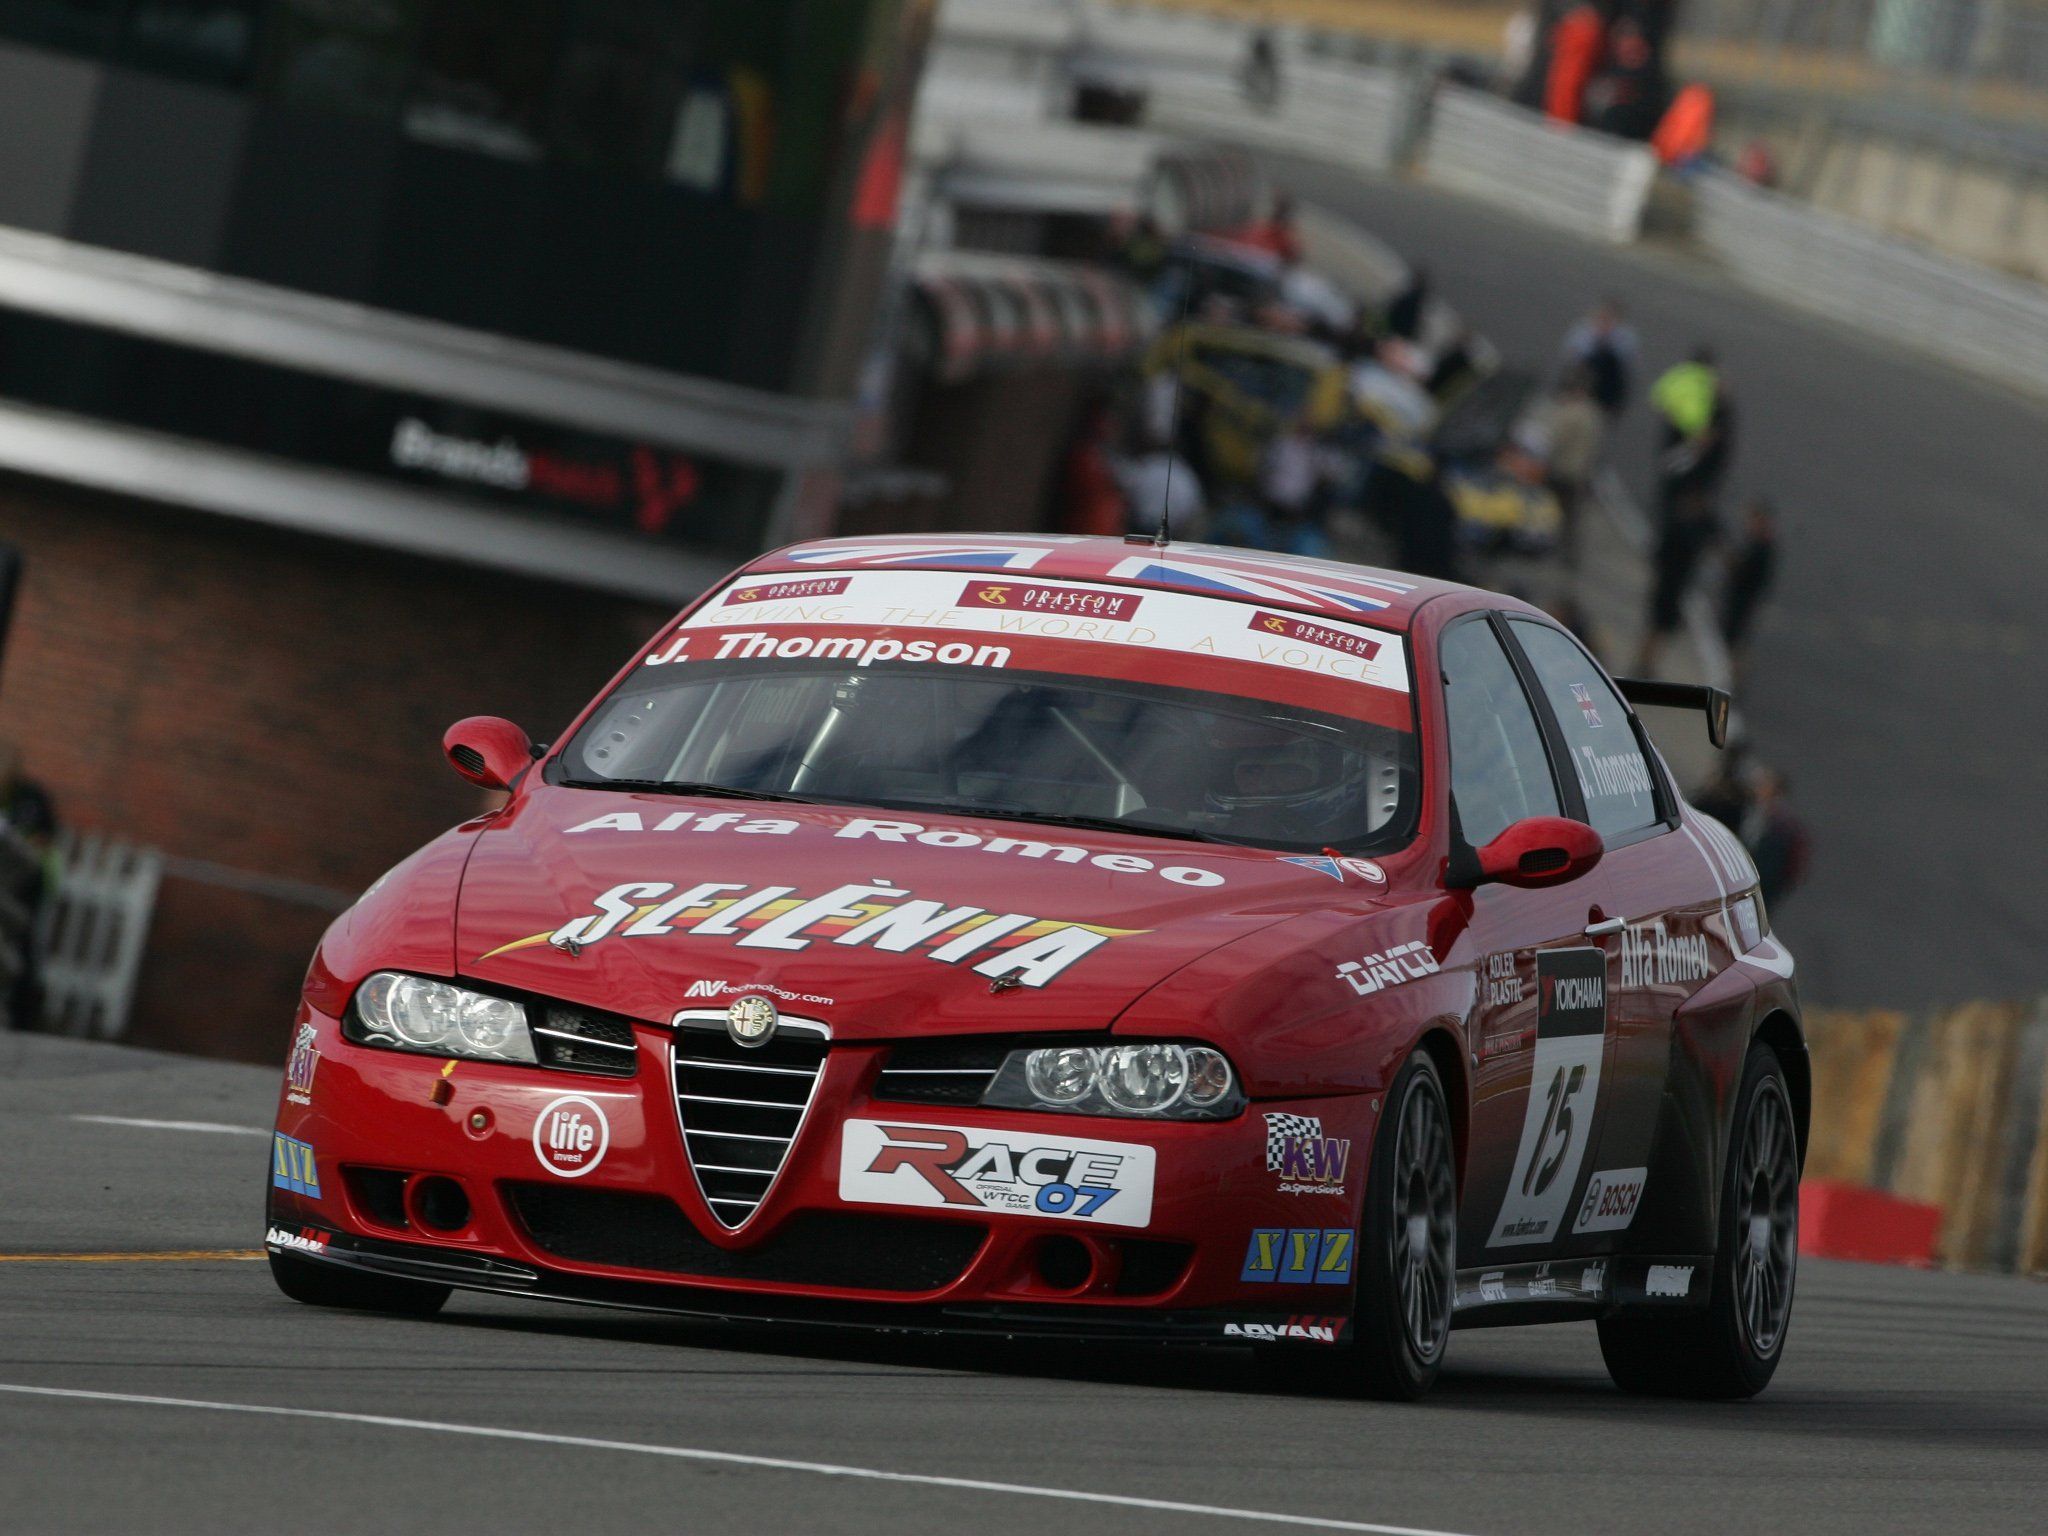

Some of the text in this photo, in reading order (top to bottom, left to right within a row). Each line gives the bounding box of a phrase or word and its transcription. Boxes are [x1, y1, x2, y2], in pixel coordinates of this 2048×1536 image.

[768, 580, 839, 595] ORASCOM
[1023, 589, 1125, 612] ORASCOM
[1022, 602, 1117, 616] TELECOM
[645, 632, 1011, 668] J. Thompson
[709, 605, 1384, 683] GIVING THE WORLD A VOICE
[1296, 623, 1369, 653] ORASCOM
[562, 811, 1226, 888] Alfa Romeo
[1336, 939, 1441, 996] DAYCO
[1490, 952, 1516, 979] ADLER
[1620, 921, 1710, 988] Alfa Romeo
[1491, 977, 1524, 1006] PLASTIC
[1554, 976, 1604, 1011] YOKOHAMA
[549, 1111, 594, 1152] life
[1522, 1063, 1588, 1197] 15
[553, 1150, 583, 1163] invest
[863, 1124, 1125, 1208] RACE
[1279, 1137, 1351, 1183] KW
[975, 1183, 1014, 1193] OFFICIAL
[982, 1190, 1030, 1204] WTCC
[1035, 1182, 1121, 1217] 07
[1597, 1182, 1642, 1217] BOSCH
[1004, 1202, 1032, 1211] GAME
[1248, 1233, 1351, 1272] XYZ
[1223, 1323, 1335, 1343] ADVAN
